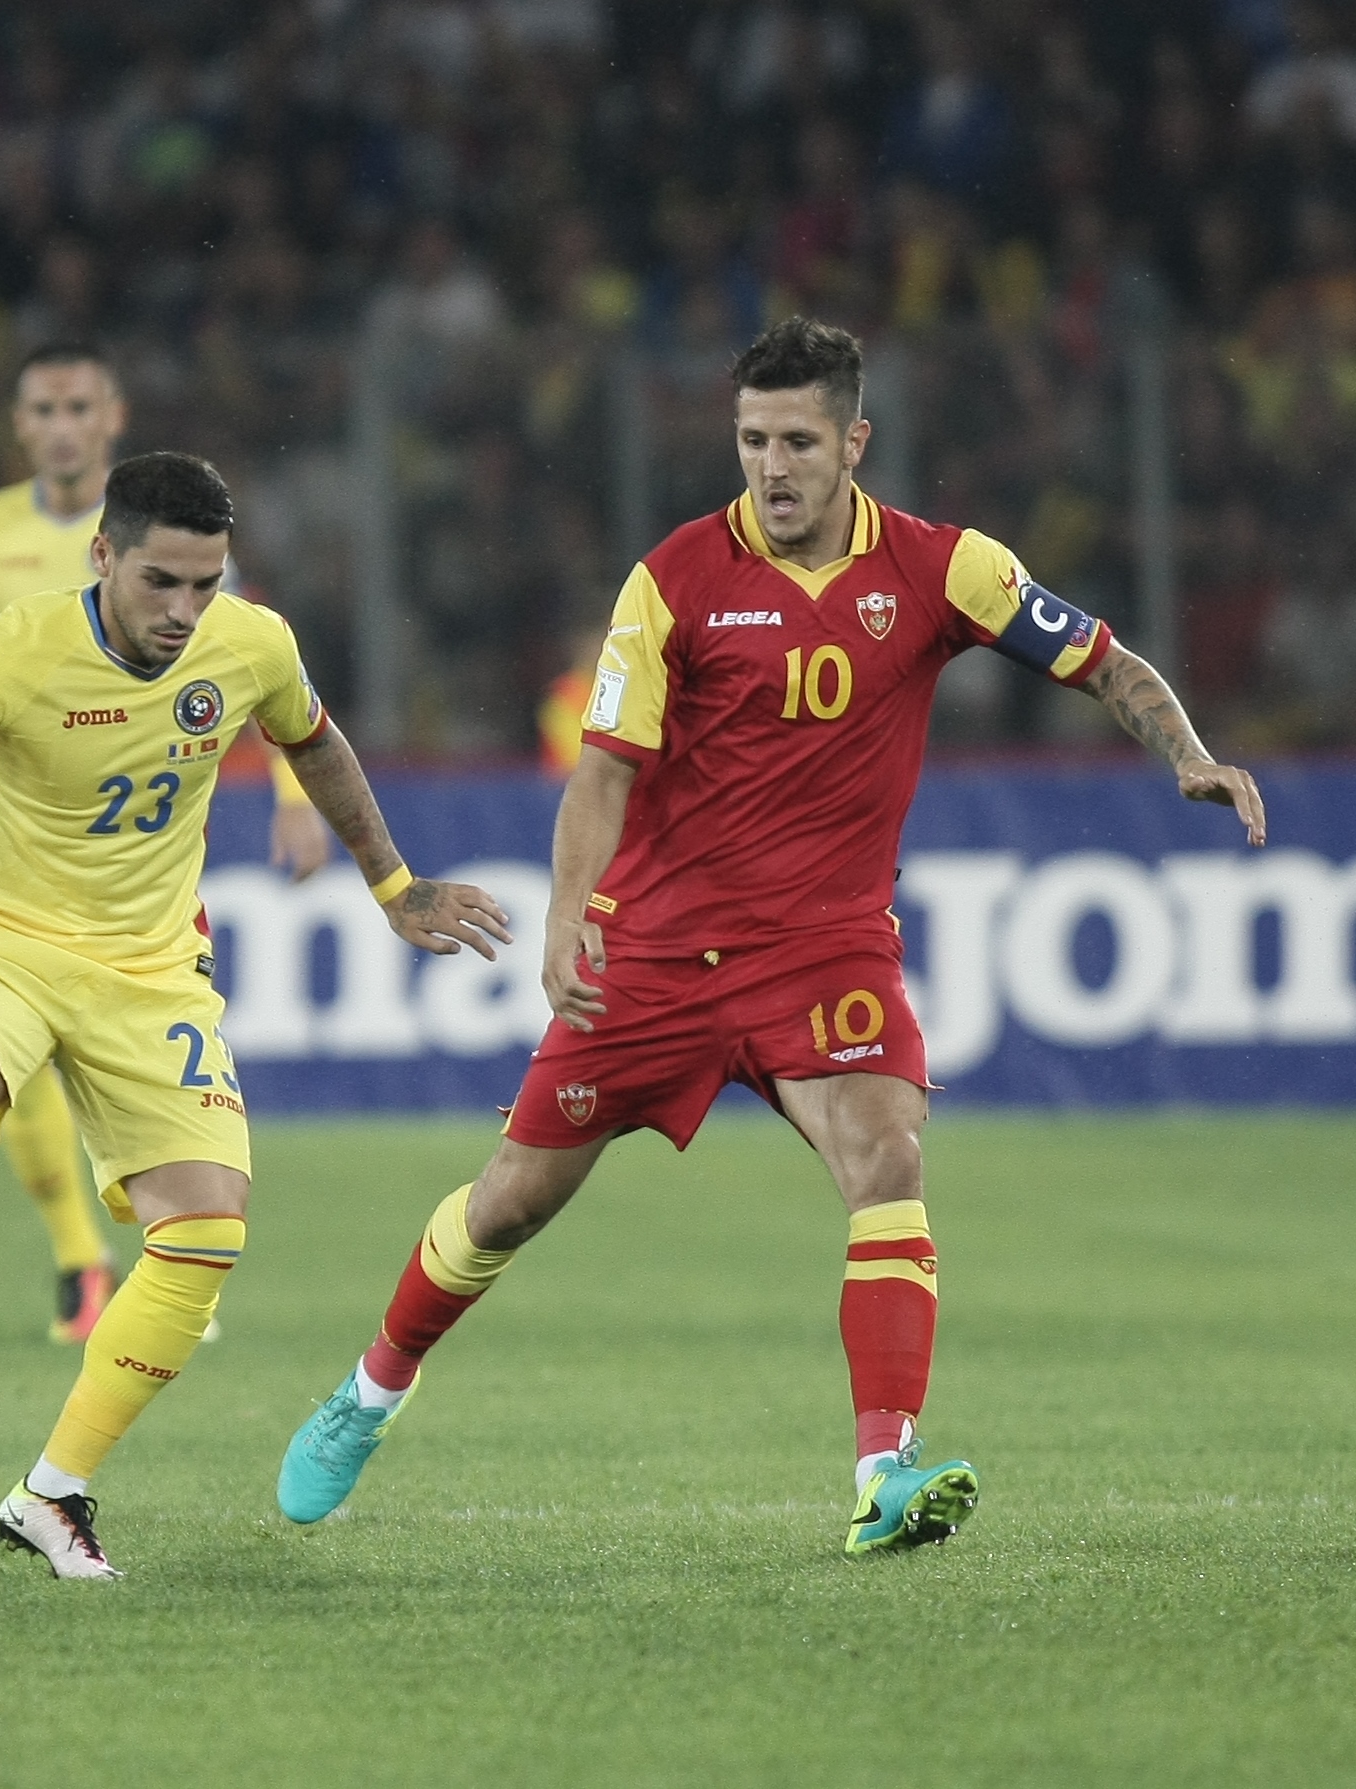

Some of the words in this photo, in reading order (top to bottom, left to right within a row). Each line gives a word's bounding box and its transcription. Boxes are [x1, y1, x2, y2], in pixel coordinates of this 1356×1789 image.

[706, 611, 783, 627] LEGEA
[1030, 597, 1068, 632] C
[781, 644, 853, 720] 10
[86, 771, 180, 833] 23
[808, 989, 884, 1056] 10
